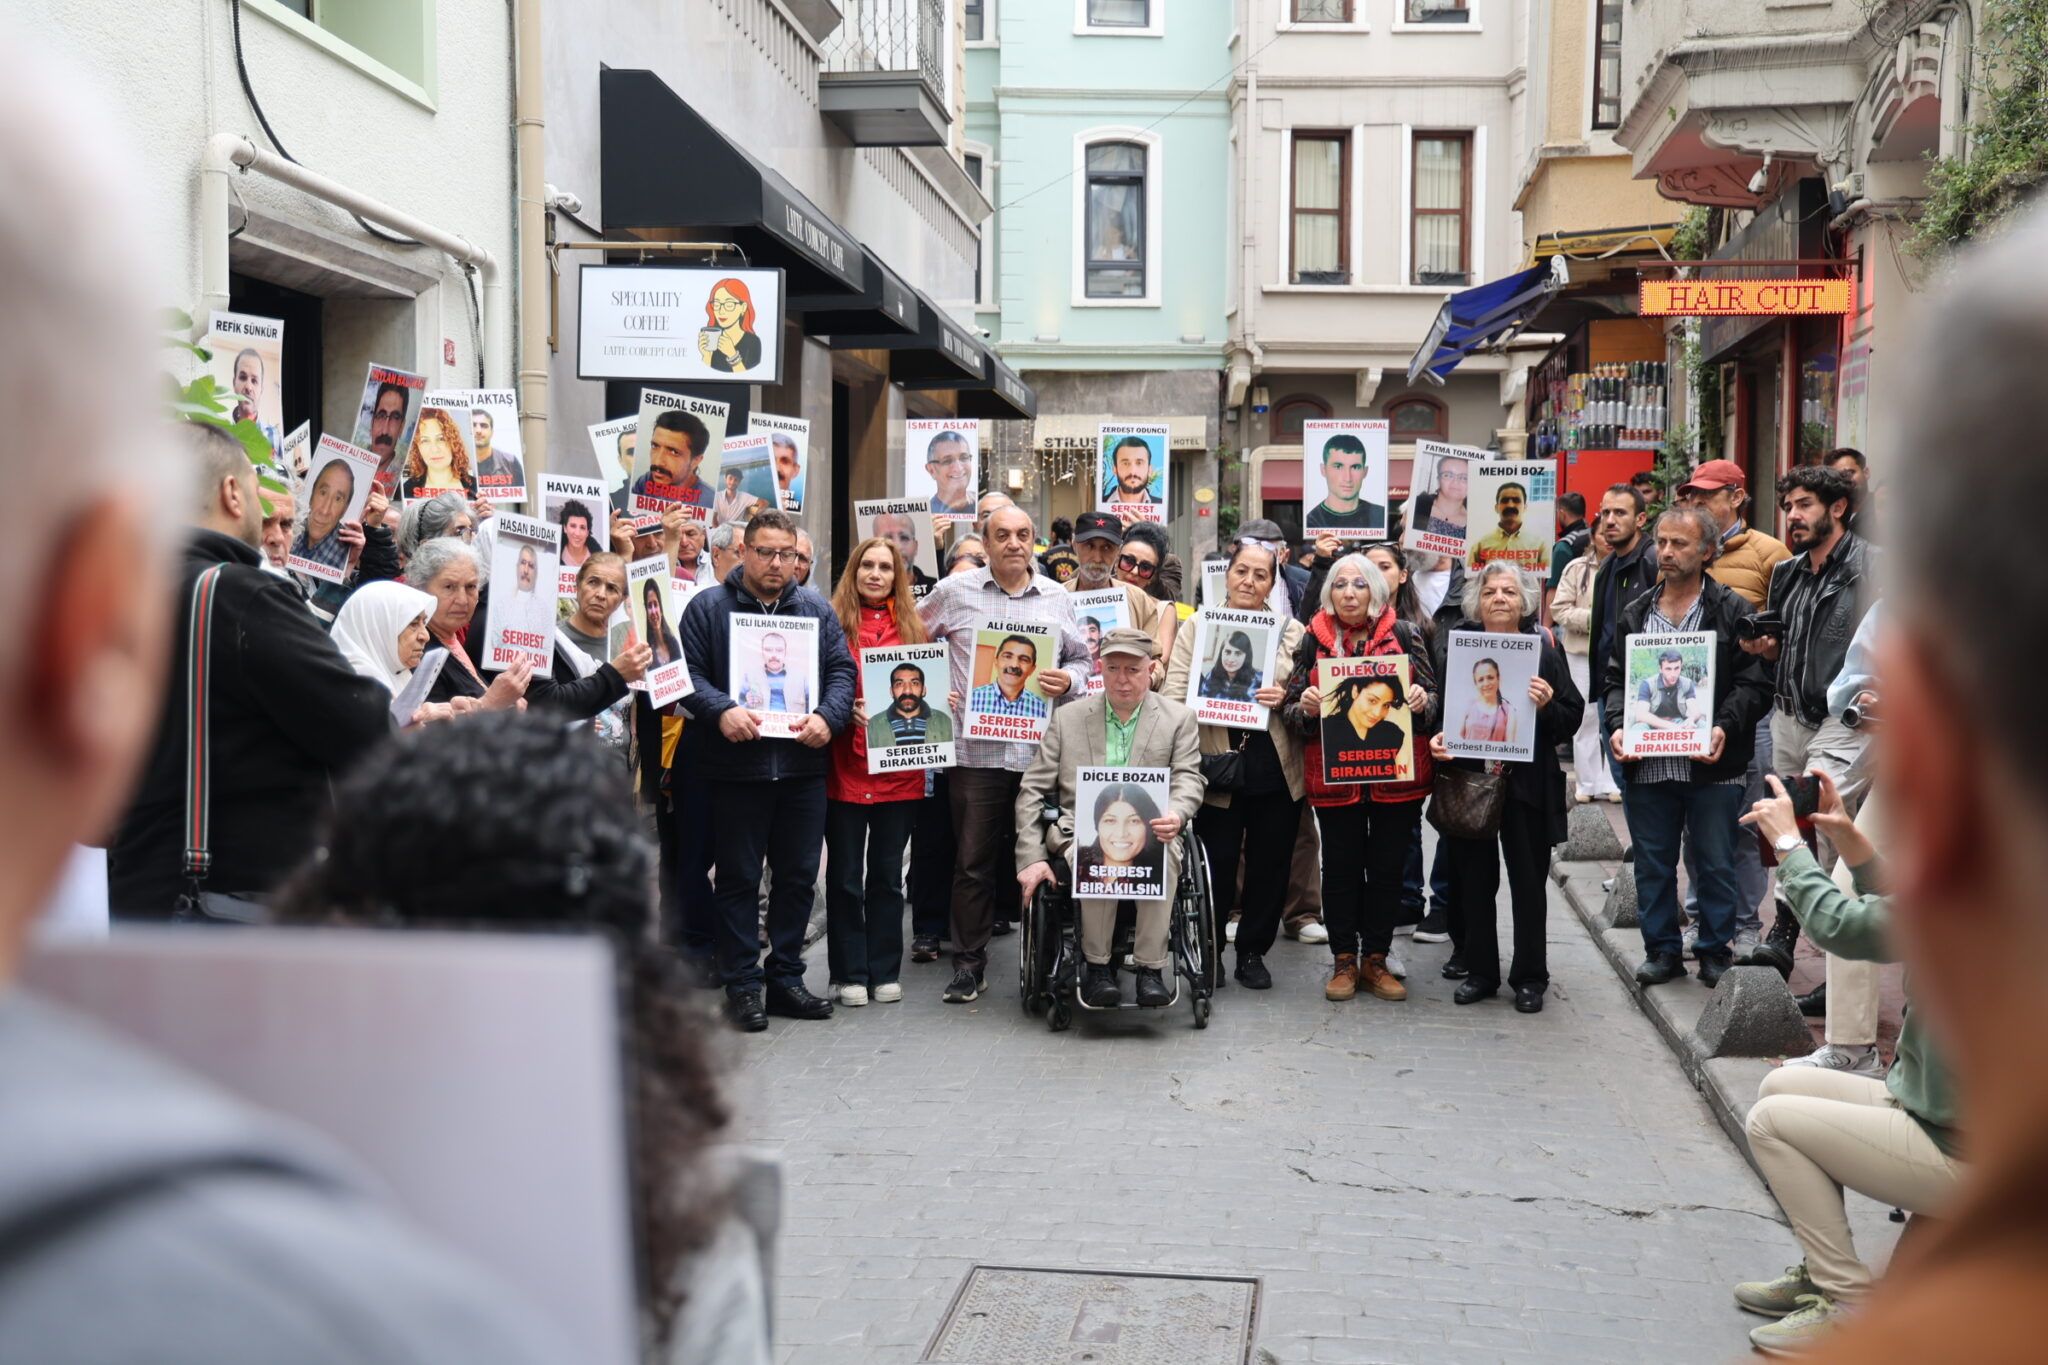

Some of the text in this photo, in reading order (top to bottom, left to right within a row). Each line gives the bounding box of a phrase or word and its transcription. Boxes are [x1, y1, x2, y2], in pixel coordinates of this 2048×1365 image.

[611, 291, 682, 308] SPECIALITY
[1666, 285, 1825, 311] HAIR CUT
[216, 319, 278, 339] REFİK SÜNKÜR
[623, 314, 670, 331] COFFEE
[477, 393, 514, 407] AKTAŞ
[645, 392, 727, 418] SERDAL SAYAK
[751, 417, 772, 428] MUSA
[908, 419, 977, 430] İSMET ASLAN
[1341, 420, 1360, 429] EMİN
[595, 426, 621, 438] RESUL
[723, 436, 767, 450] BOZKURT
[321, 436, 349, 453] MEHMET
[359, 451, 379, 465] TOSUN
[1425, 444, 1486, 460] FATMA TOKMAK
[1479, 464, 1545, 476] MEHDİ BOZ
[547, 481, 601, 497] HAVVA AK
[645, 480, 703, 504] SERBEST
[858, 501, 928, 516] KEMAL ÖZELMALI
[500, 518, 557, 542] HASAN BUDAK
[1422, 533, 1464, 547] SERBEST
[1479, 549, 1540, 560] SERBEST
[288, 555, 342, 579] RBEST BIRAKILSIN
[648, 561, 666, 574] YOLCU
[1079, 593, 1124, 606] KAYGUSUZ
[1204, 610, 1276, 628] ŞİVAKAR ATAŞ
[986, 620, 1048, 635] ALİ GÜLMEZ
[502, 629, 545, 649] SERBEST
[1455, 636, 1533, 651] BESİYE ÖZER
[1634, 636, 1706, 647] GÜRBÜZ TOPÇU
[865, 647, 944, 664] İSMAİL TÜZÜN
[654, 666, 680, 685] SERBEST
[1331, 660, 1397, 677] DİLEK ÖZ
[654, 678, 688, 700] BIRAKILSIN
[1206, 700, 1254, 713] SERBEST
[979, 714, 1036, 729] SERBEST
[1198, 710, 1258, 724] BIRAKILSIN
[969, 725, 1042, 741] BIRAKILSIN
[1642, 731, 1695, 742] SERBEST
[885, 744, 940, 758] SERBEST
[1338, 748, 1398, 762] SERBEST
[1447, 741, 1529, 755] Serbest Bırakılsın
[1634, 743, 1701, 753] BIRAKILSIN
[879, 755, 947, 769] BIRAKILSIN
[1082, 769, 1165, 783] DİCLE BOZAN
[1330, 763, 1408, 778] BIRAKILSIN
[1088, 865, 1153, 878] SERBEST
[1080, 882, 1161, 895] BIRAKILSIN
